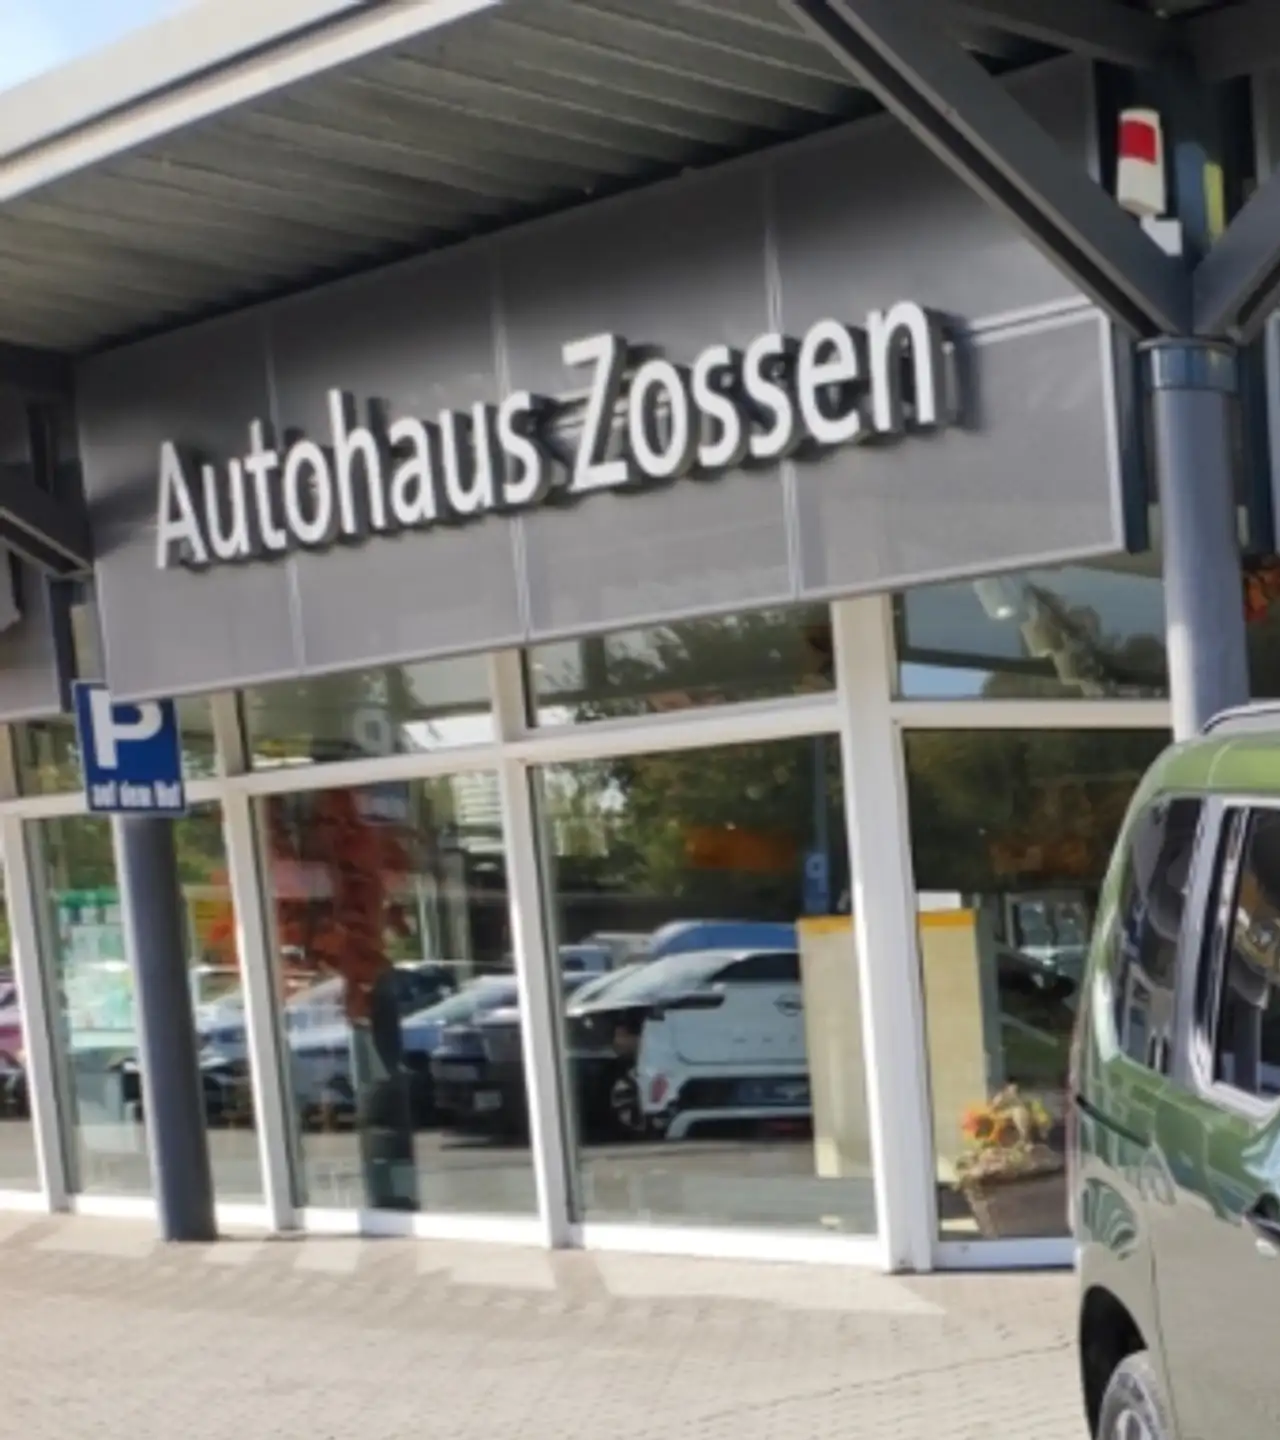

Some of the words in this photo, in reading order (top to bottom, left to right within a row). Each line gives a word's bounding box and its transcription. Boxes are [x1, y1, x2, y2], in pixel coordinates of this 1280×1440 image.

[154, 386, 541, 568] Autohaus
[562, 299, 936, 492] Zossen
[90, 690, 163, 770] P
